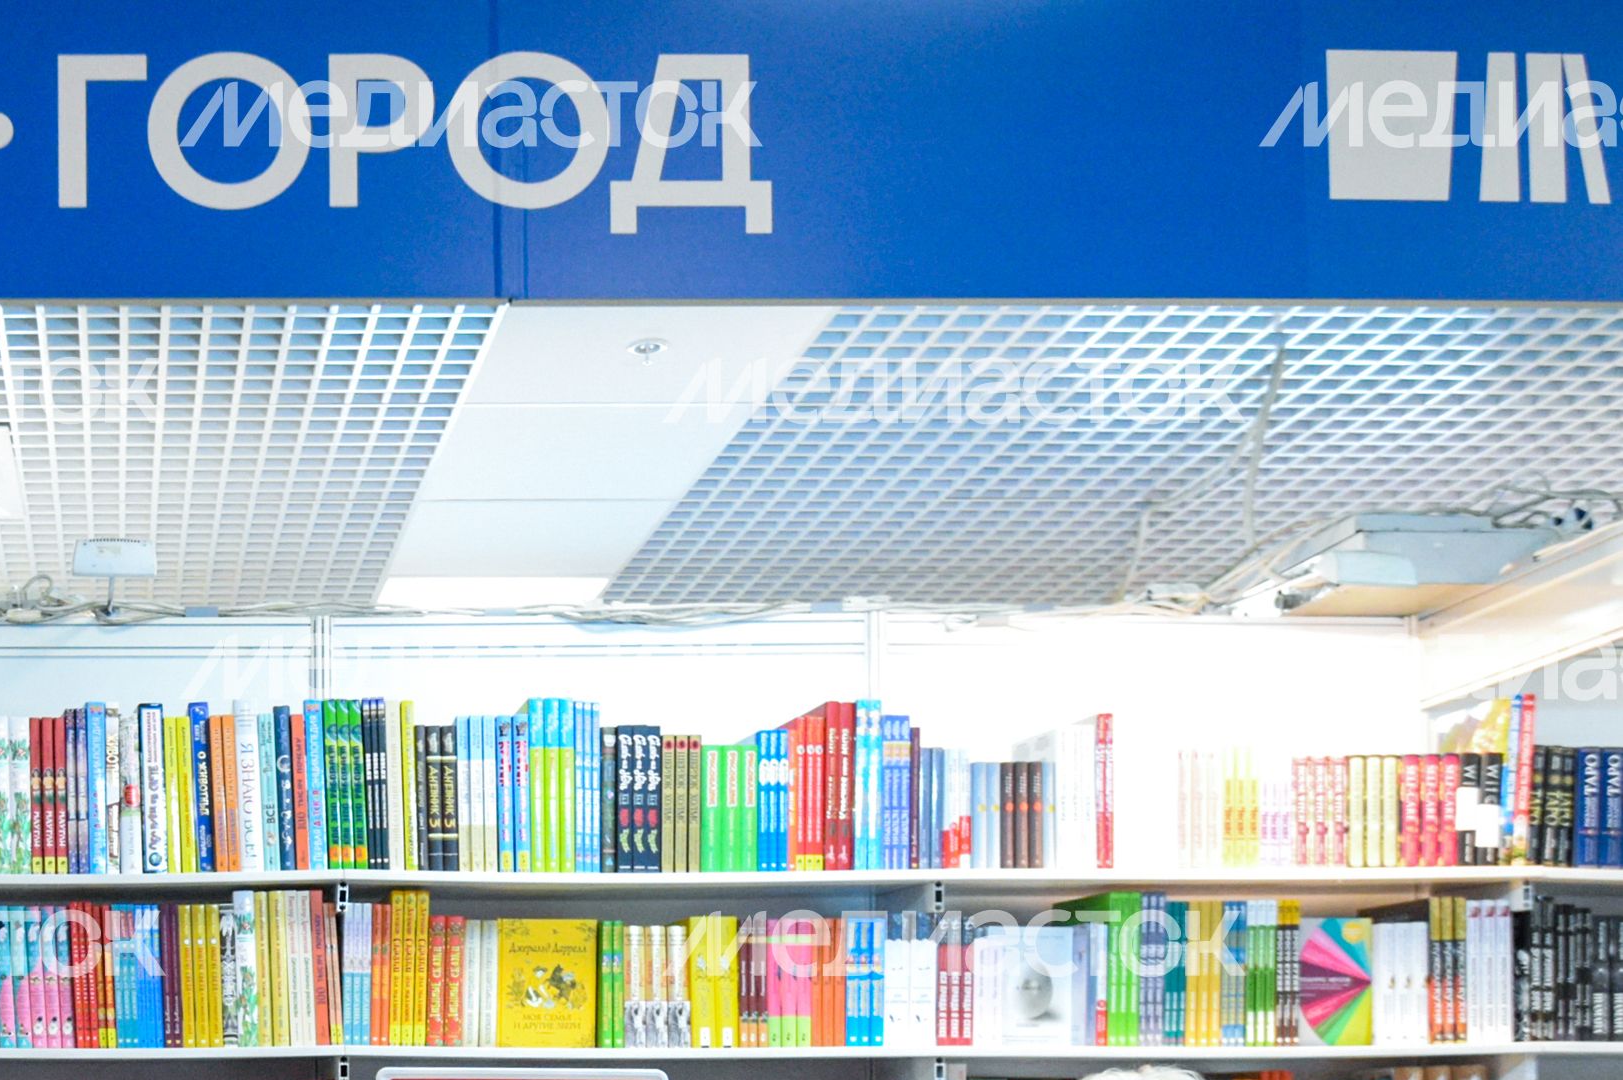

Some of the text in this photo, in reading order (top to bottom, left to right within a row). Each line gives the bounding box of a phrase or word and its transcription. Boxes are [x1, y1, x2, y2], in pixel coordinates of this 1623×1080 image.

[1405, 764, 1418, 821] SELF-CARE
[1425, 764, 1437, 821] SELF-CARE
[1444, 764, 1456, 821] SELF-CARE
[1584, 752, 1598, 795] ТАРО
[1607, 752, 1621, 795] ТАРО
[33, 810, 42, 848] МАУГЛИ
[45, 810, 54, 848] МАУГЛИ
[57, 810, 66, 848] МАУГЛИ
